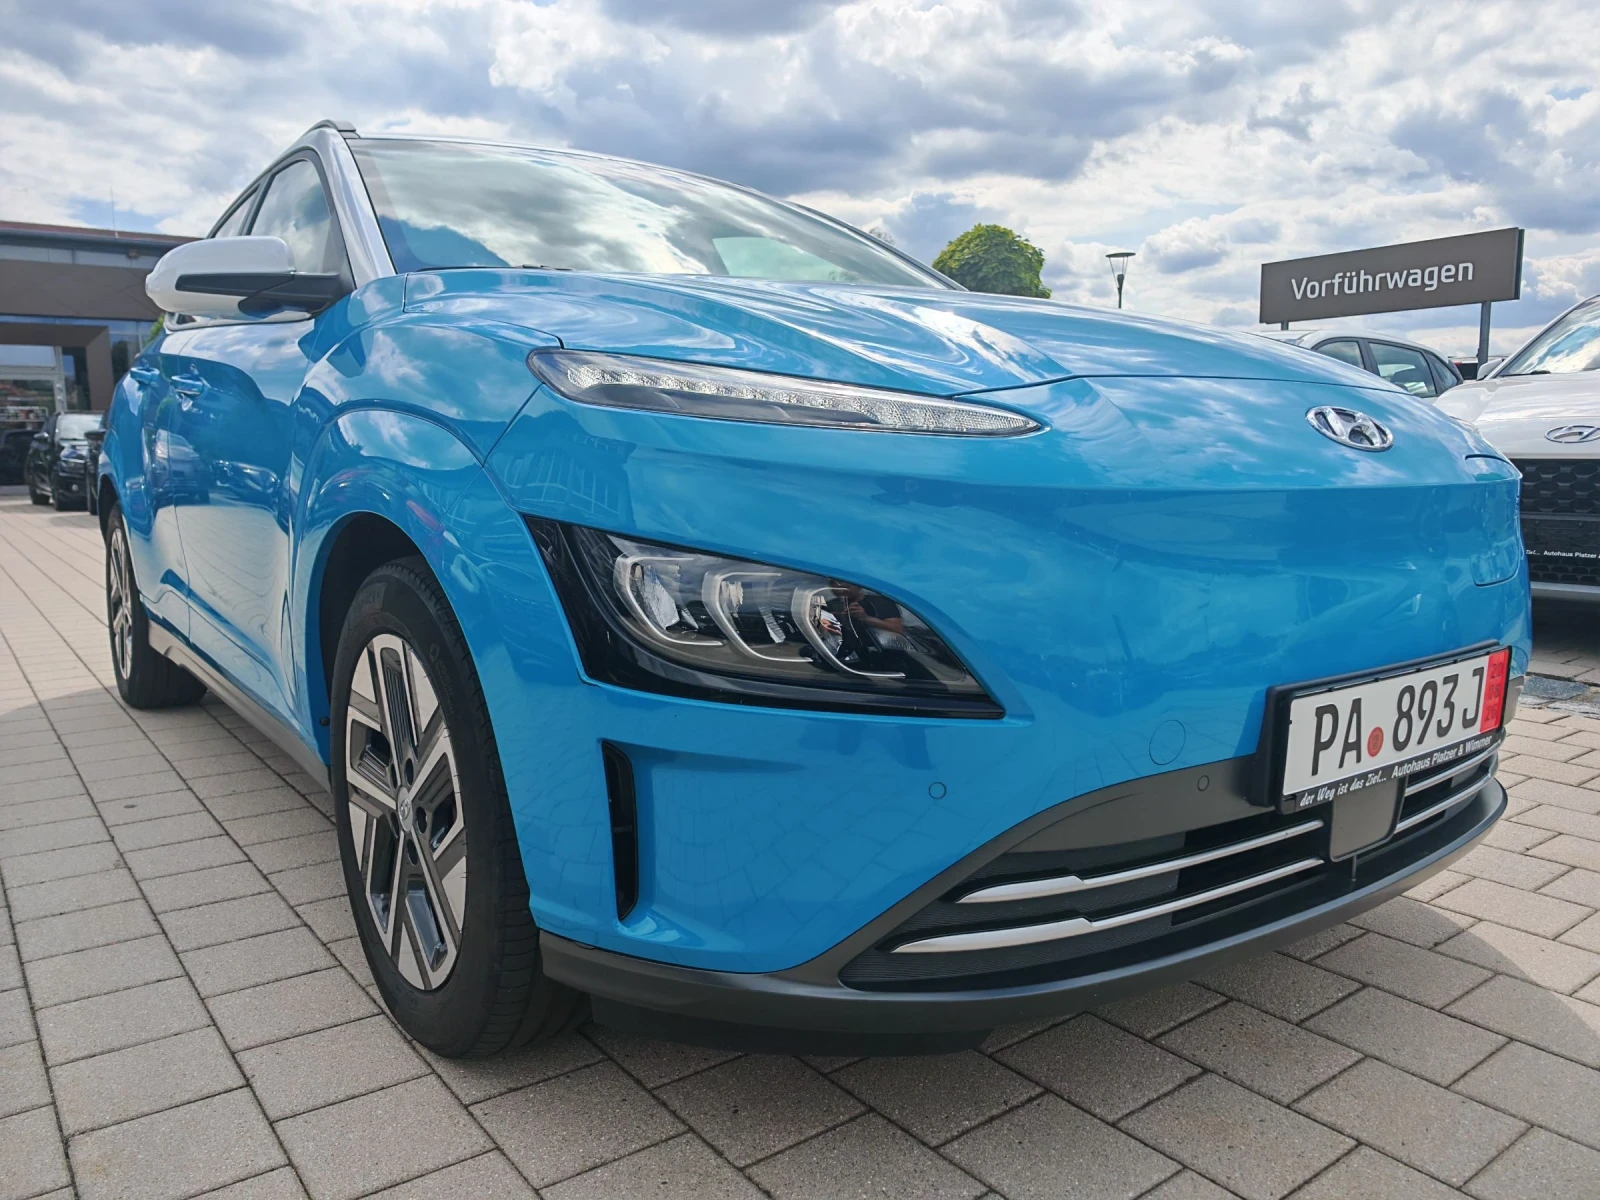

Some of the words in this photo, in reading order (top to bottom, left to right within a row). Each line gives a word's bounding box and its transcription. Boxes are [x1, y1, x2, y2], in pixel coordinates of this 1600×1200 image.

[1291, 262, 1474, 300] Vorführwagen
[1574, 551, 1597, 559] Platzer
[1311, 697, 1362, 776] PA
[1300, 792, 1315, 807] der
[1316, 785, 1336, 802] Weg
[1337, 783, 1349, 796] ist
[1349, 777, 1365, 791] das
[1391, 757, 1430, 778] Autohaus
[1431, 747, 1458, 765] Platzer
[1458, 743, 1464, 756] &
[1465, 735, 1493, 753] Wimmer
